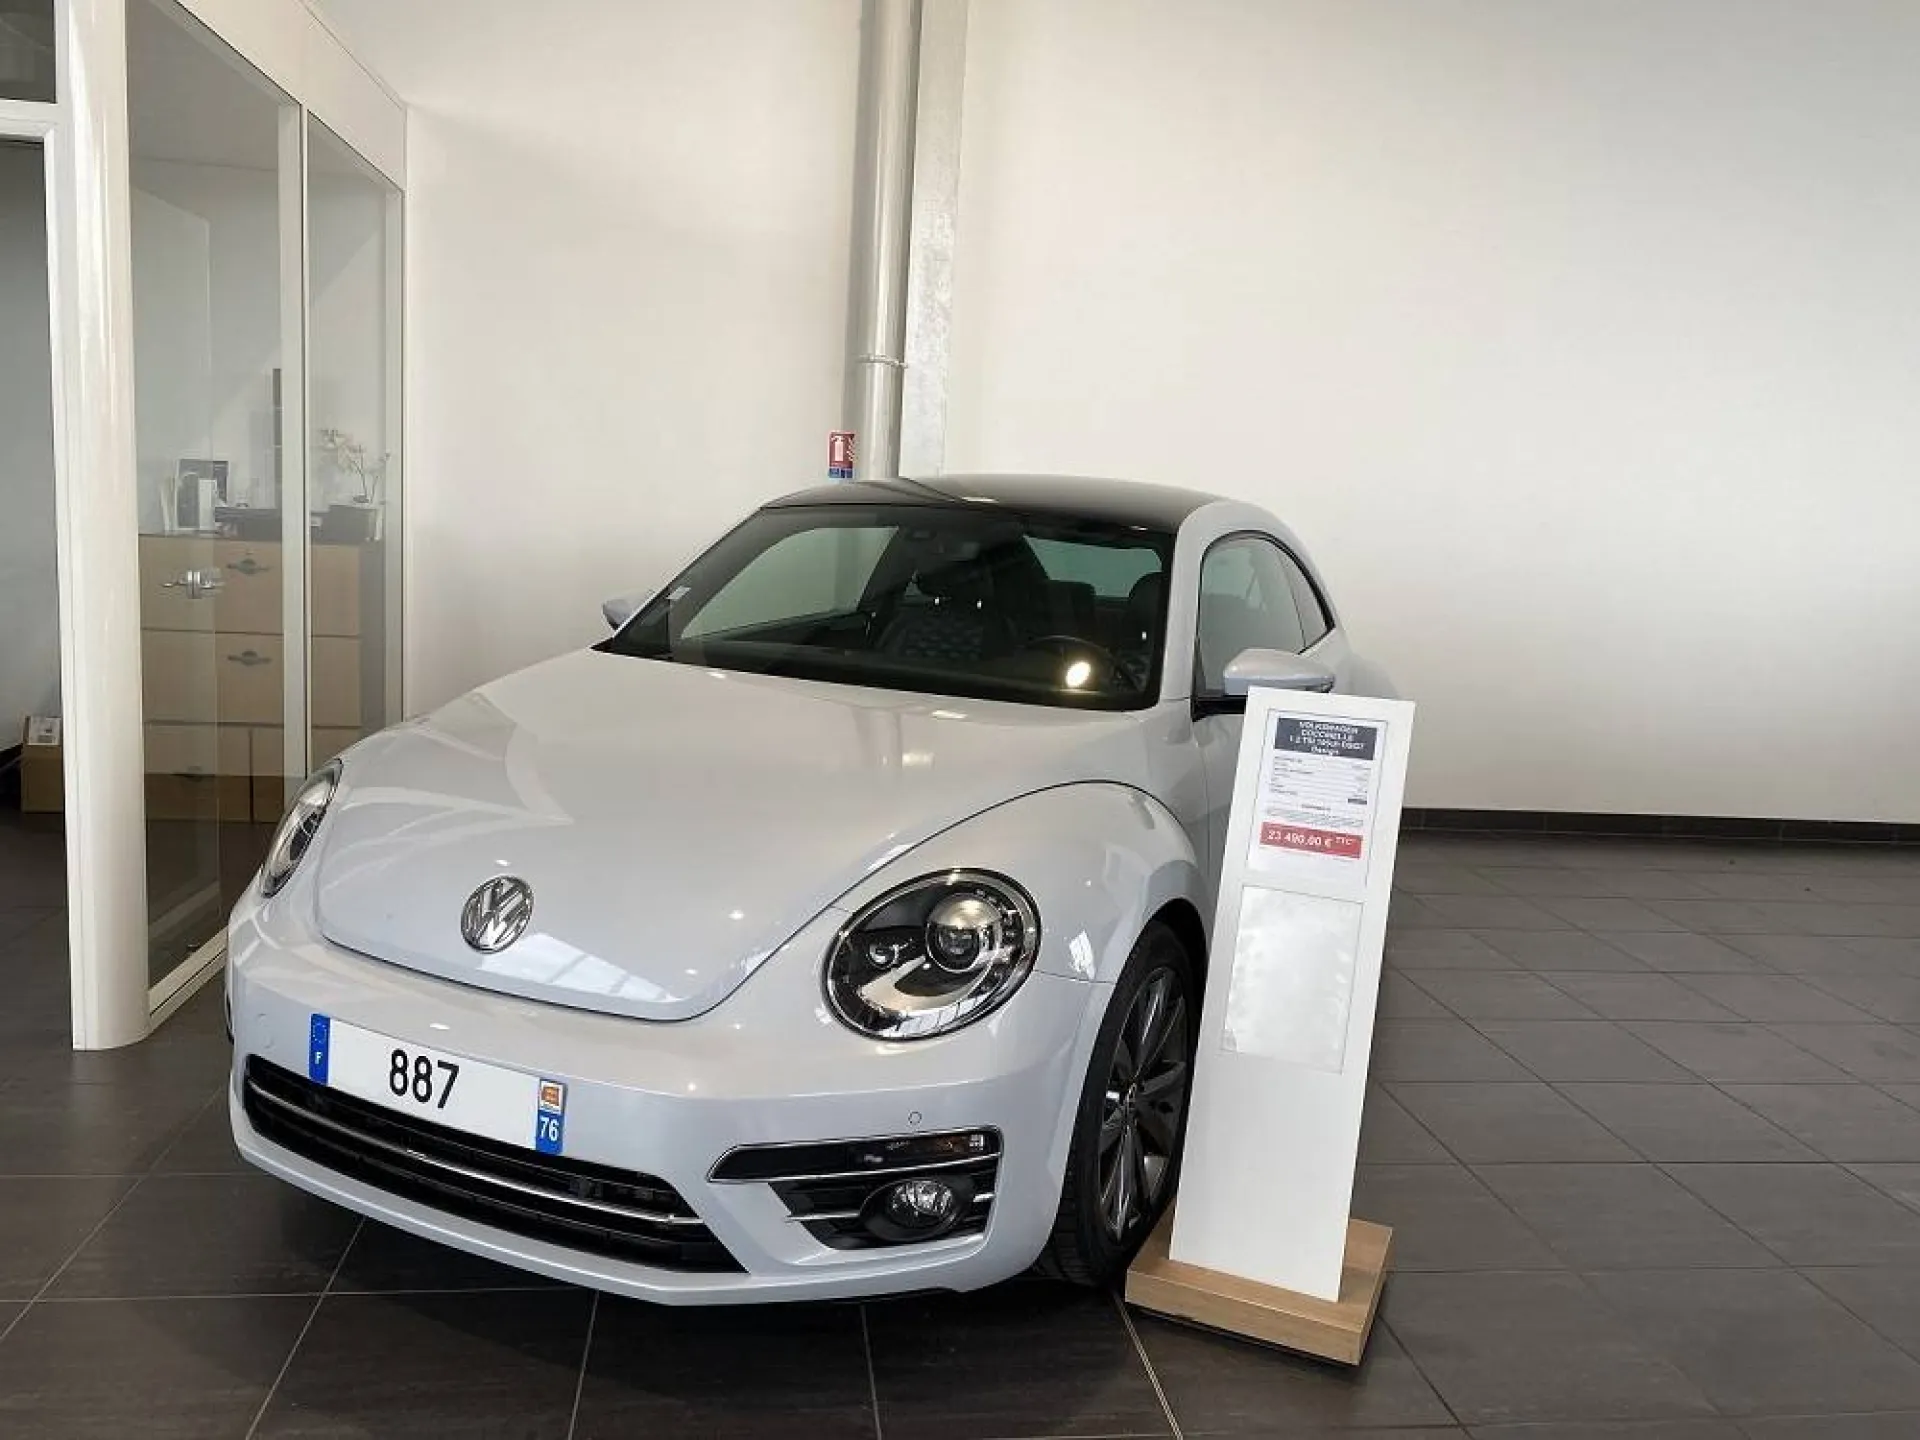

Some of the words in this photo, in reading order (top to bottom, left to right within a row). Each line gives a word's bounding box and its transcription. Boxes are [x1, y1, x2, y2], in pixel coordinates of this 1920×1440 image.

[1267, 830, 1281, 840] 23
[315, 1051, 322, 1064] F
[389, 1048, 459, 1109] 887
[539, 1116, 559, 1142] 76
